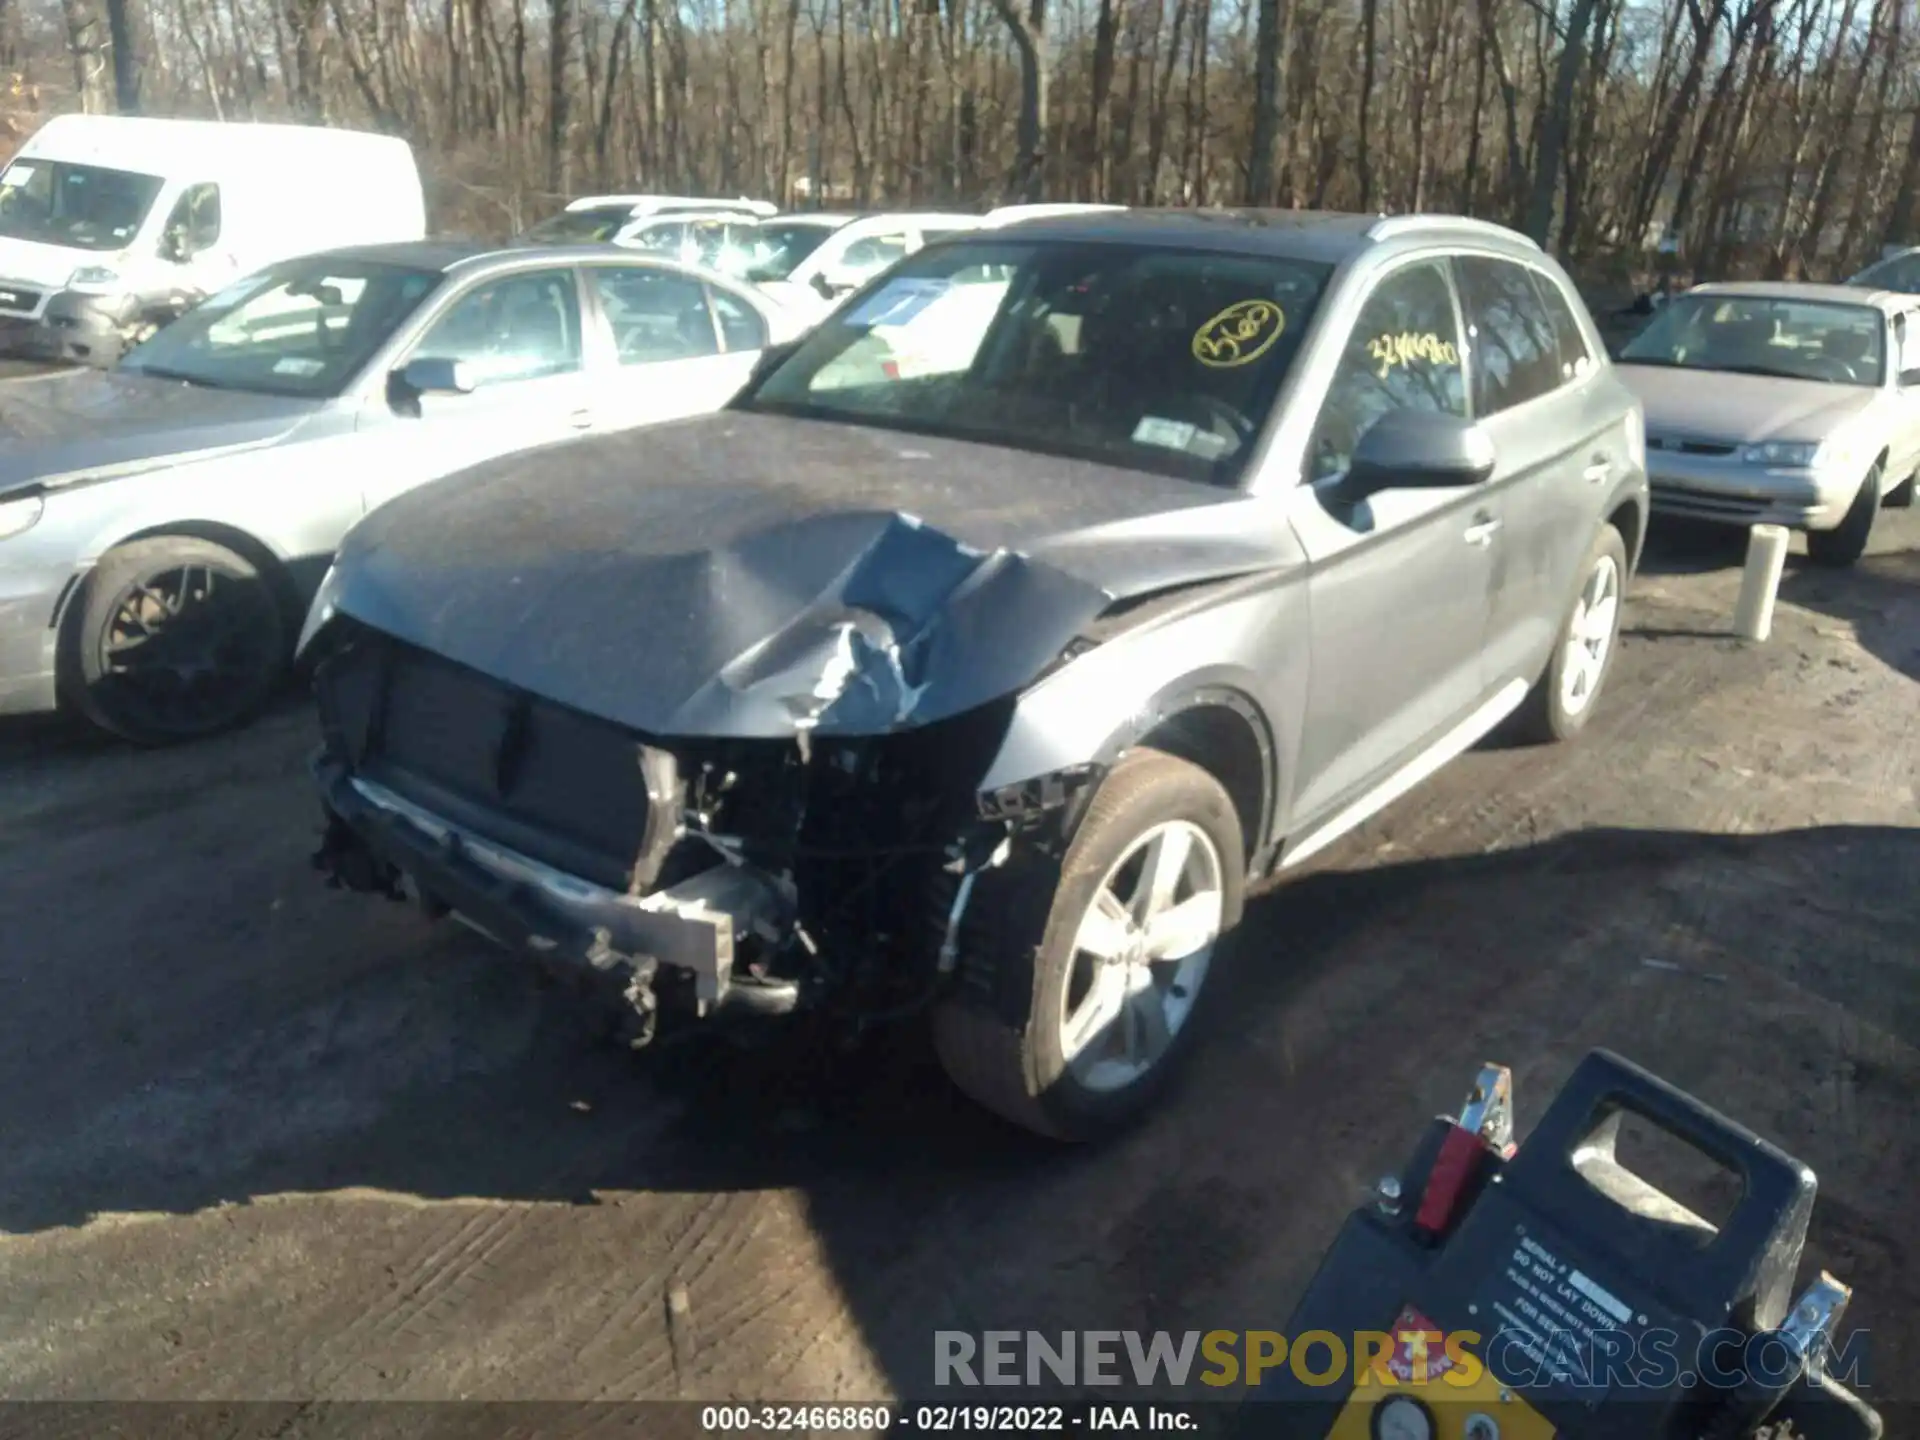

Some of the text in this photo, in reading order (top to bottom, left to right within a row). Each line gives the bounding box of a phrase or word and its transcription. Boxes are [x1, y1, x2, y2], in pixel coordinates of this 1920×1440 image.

[1513, 1249, 1617, 1331] DO NOT LAY DOWN
